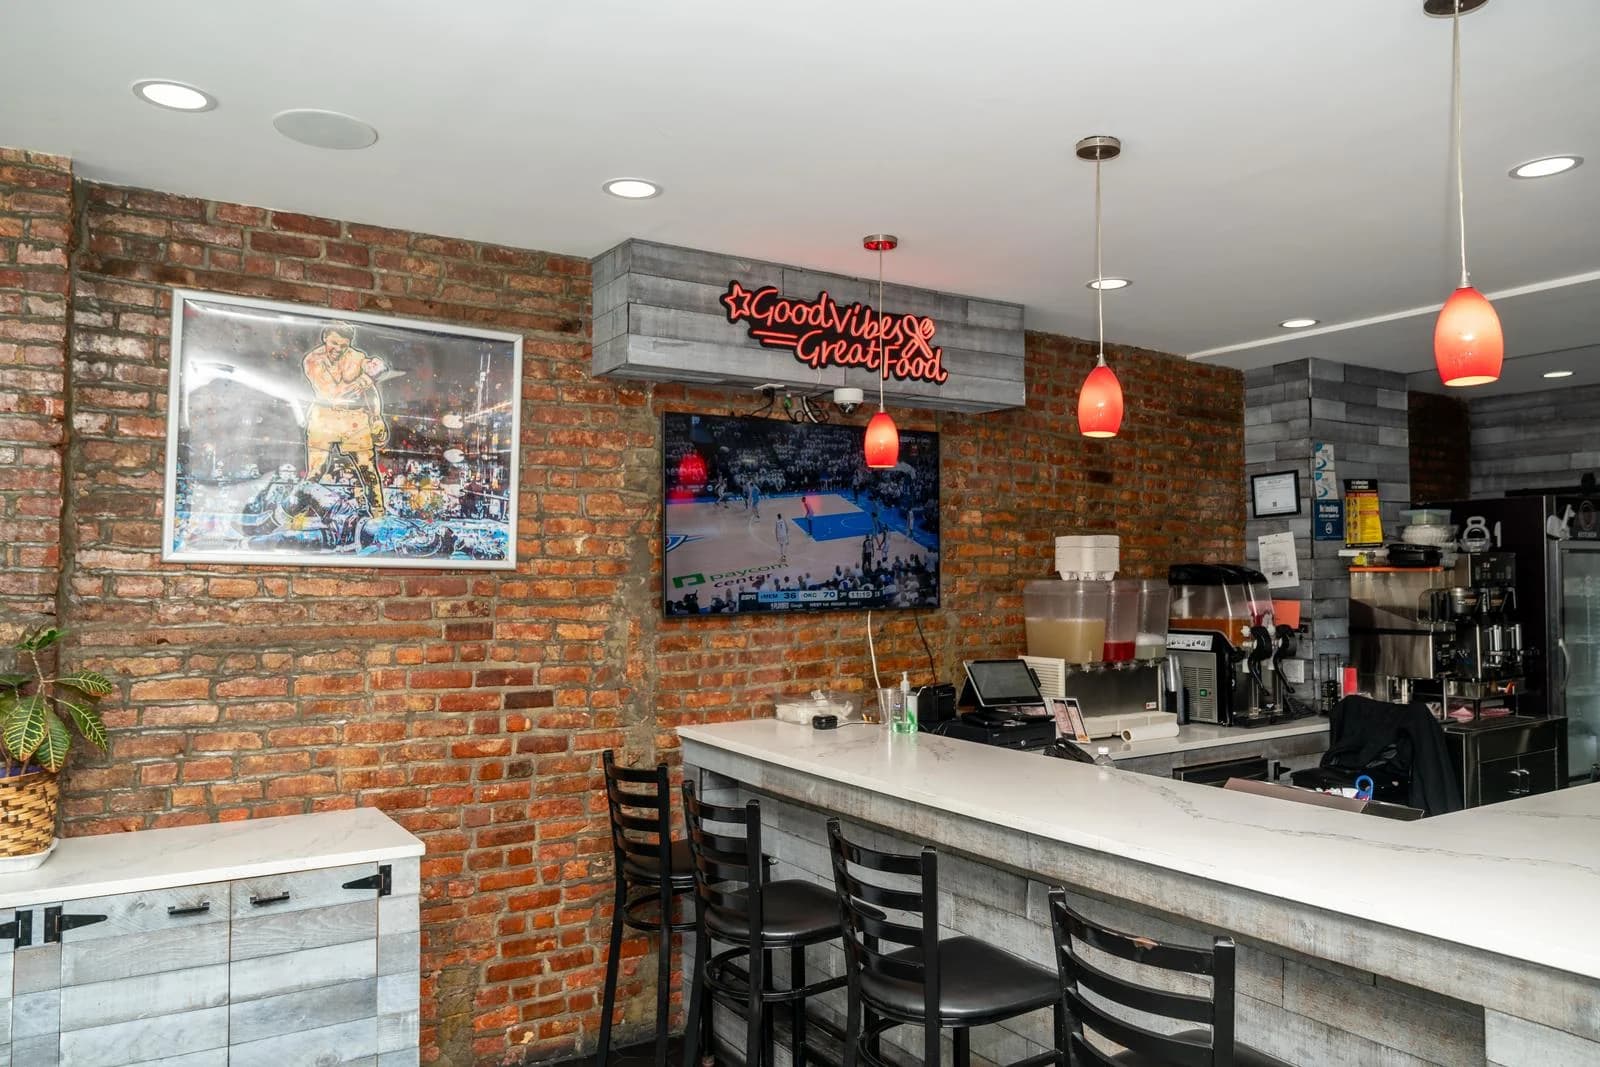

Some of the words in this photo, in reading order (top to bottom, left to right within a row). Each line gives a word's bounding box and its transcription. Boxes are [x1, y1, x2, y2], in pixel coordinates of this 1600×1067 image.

[750, 289, 834, 327] Good
[829, 302, 904, 343] Vibes
[797, 329, 880, 368] Great
[882, 344, 948, 381] Food
[709, 563, 789, 582] paycom
[714, 573, 773, 588] center
[784, 592, 797, 600] 36
